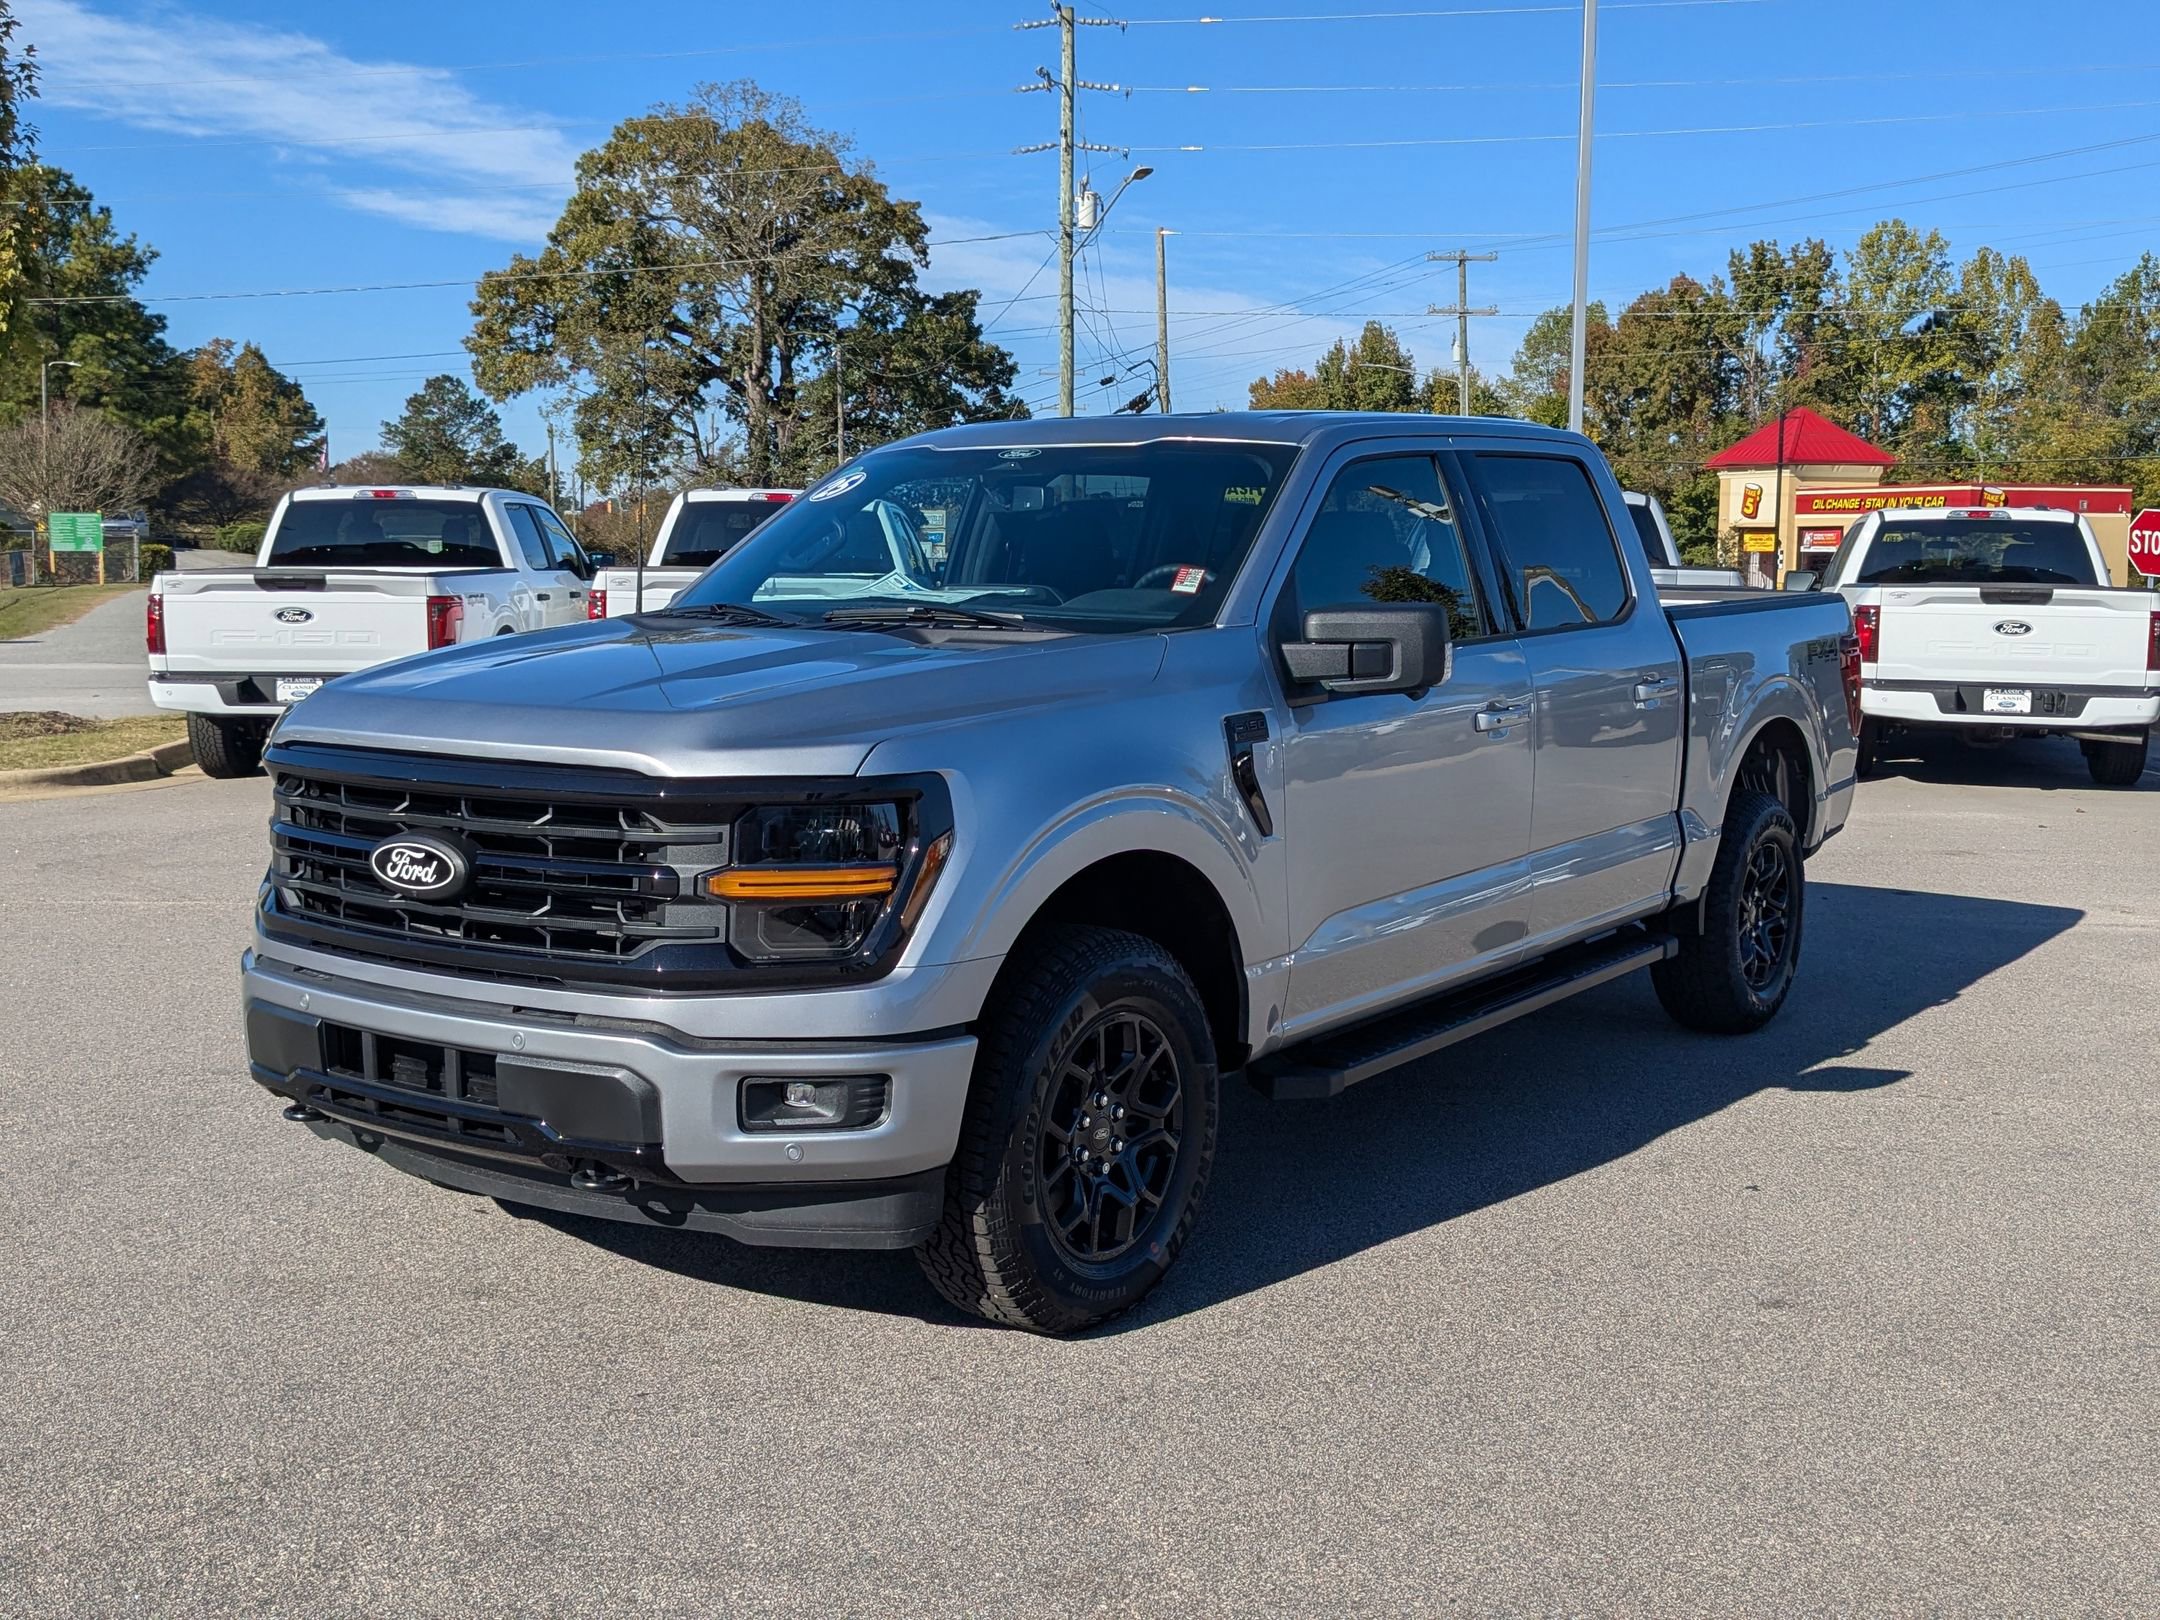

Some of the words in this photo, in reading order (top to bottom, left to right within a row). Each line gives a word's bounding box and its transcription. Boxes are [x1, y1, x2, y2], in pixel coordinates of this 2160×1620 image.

[1812, 499, 1825, 510] OIL
[1825, 498, 1861, 509] CHANGE
[1864, 497, 1887, 508] STAY
[1887, 497, 1897, 507] IN
[1924, 496, 1945, 507] CAR
[1983, 491, 2000, 501] TAKE
[1743, 496, 1754, 514] 5
[281, 610, 307, 621] Ford
[2000, 622, 2026, 634] Ford
[211, 629, 382, 647] F-150
[386, 848, 438, 883] Ford
